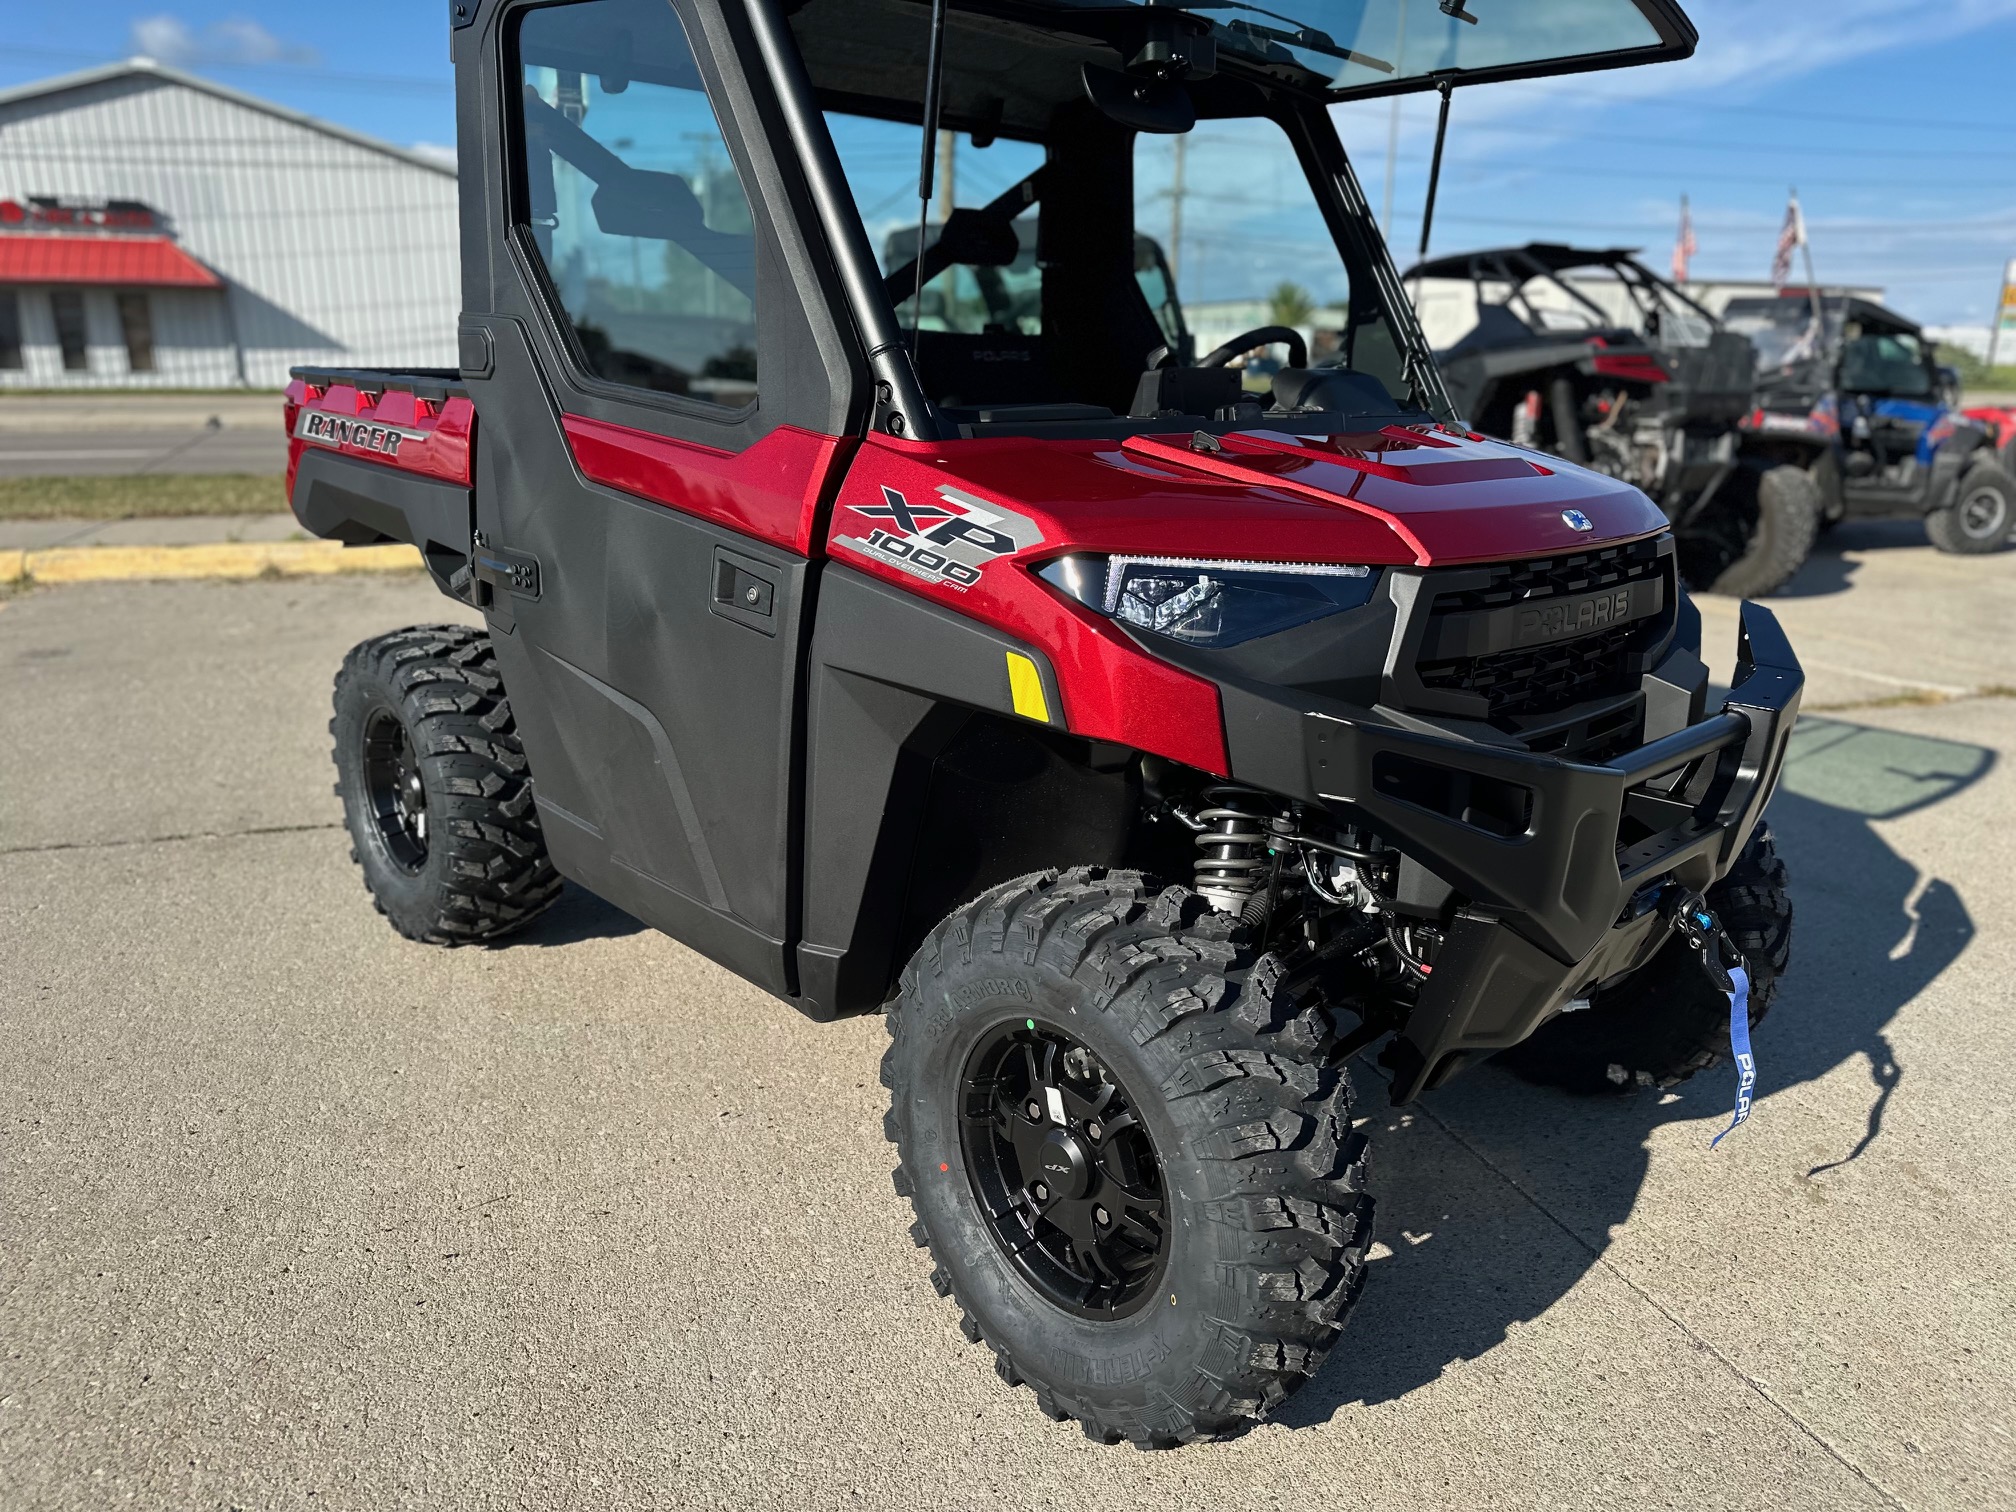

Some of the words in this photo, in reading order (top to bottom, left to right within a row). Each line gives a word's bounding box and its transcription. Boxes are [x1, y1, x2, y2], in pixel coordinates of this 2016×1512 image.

[307, 413, 402, 455] RANGER
[844, 484, 1018, 556] XP
[862, 546, 887, 561] DUAL
[889, 557, 943, 583] OVERHEAD
[943, 578, 969, 594] CAM
[865, 528, 983, 586] 1000
[1520, 590, 1630, 640] POLARIS
[950, 977, 1014, 1012] ARMOR
[1045, 1165, 1070, 1174] XP
[1050, 1329, 1172, 1387] X-TERRAIN
